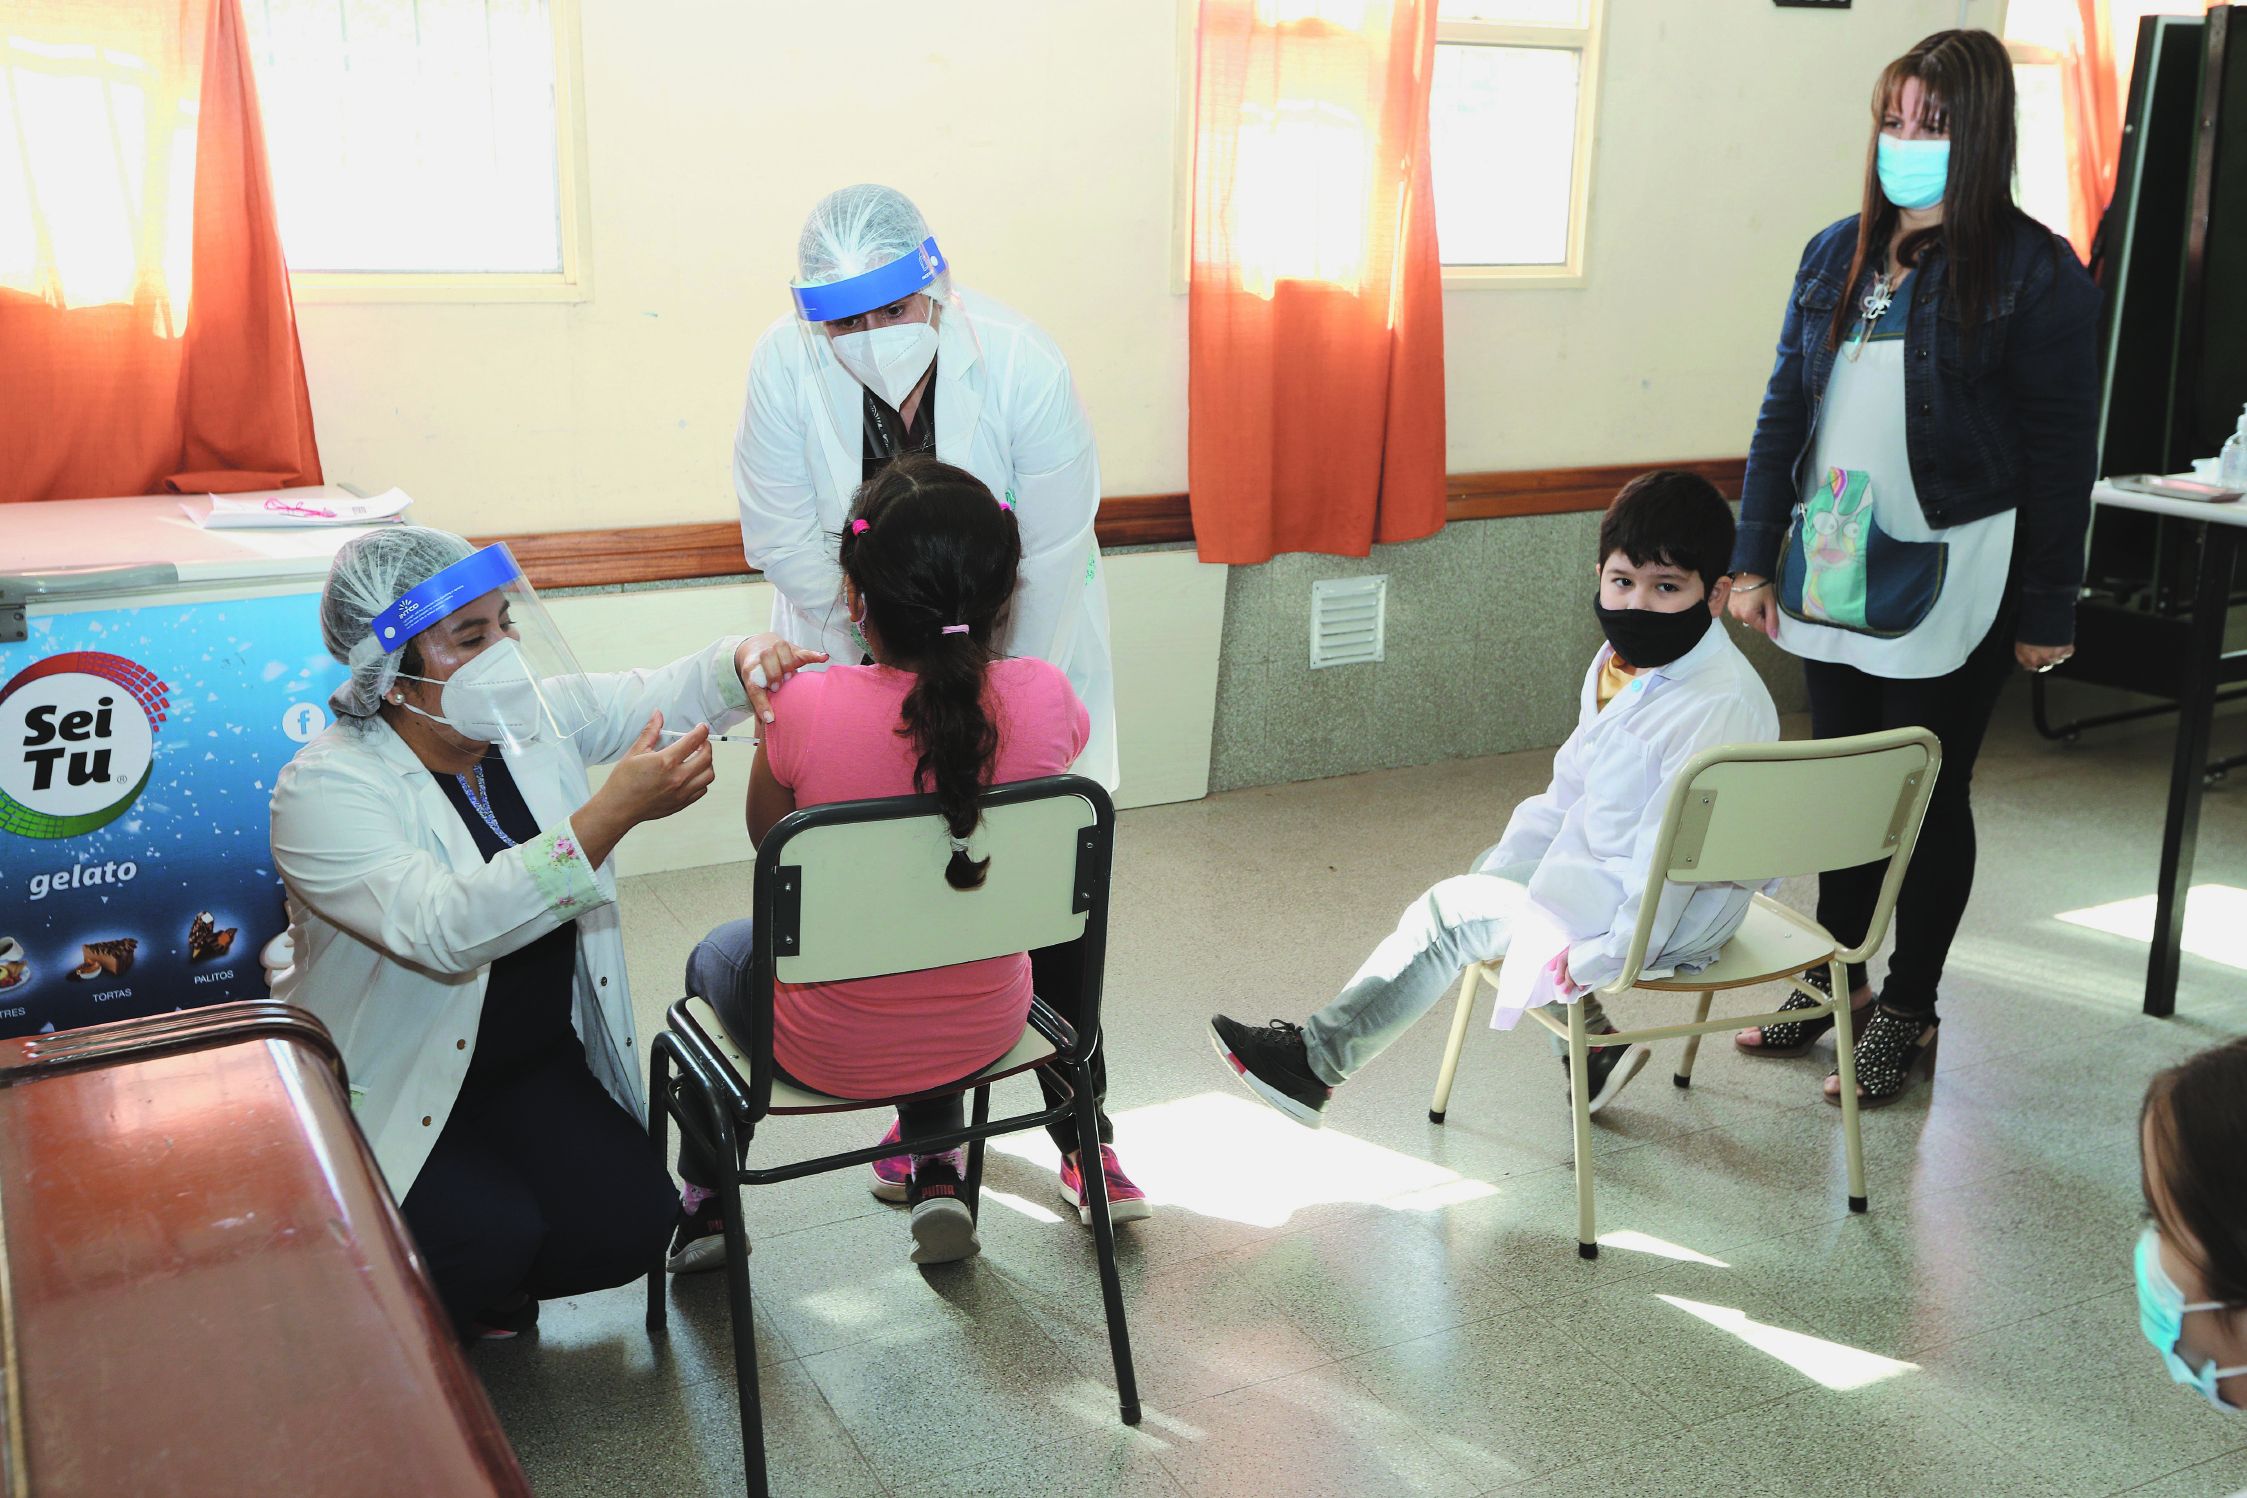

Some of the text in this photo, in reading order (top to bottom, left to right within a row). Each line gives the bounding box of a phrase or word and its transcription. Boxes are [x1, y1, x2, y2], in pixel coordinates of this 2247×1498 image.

[398, 602, 420, 620] INTCO
[22, 696, 114, 747] Sei
[23, 746, 113, 791] Tu
[29, 859, 138, 901] gelato
[193, 969, 235, 985] PALITOS
[92, 988, 133, 1003] TORTAS
[921, 1183, 956, 1199] PUMA
